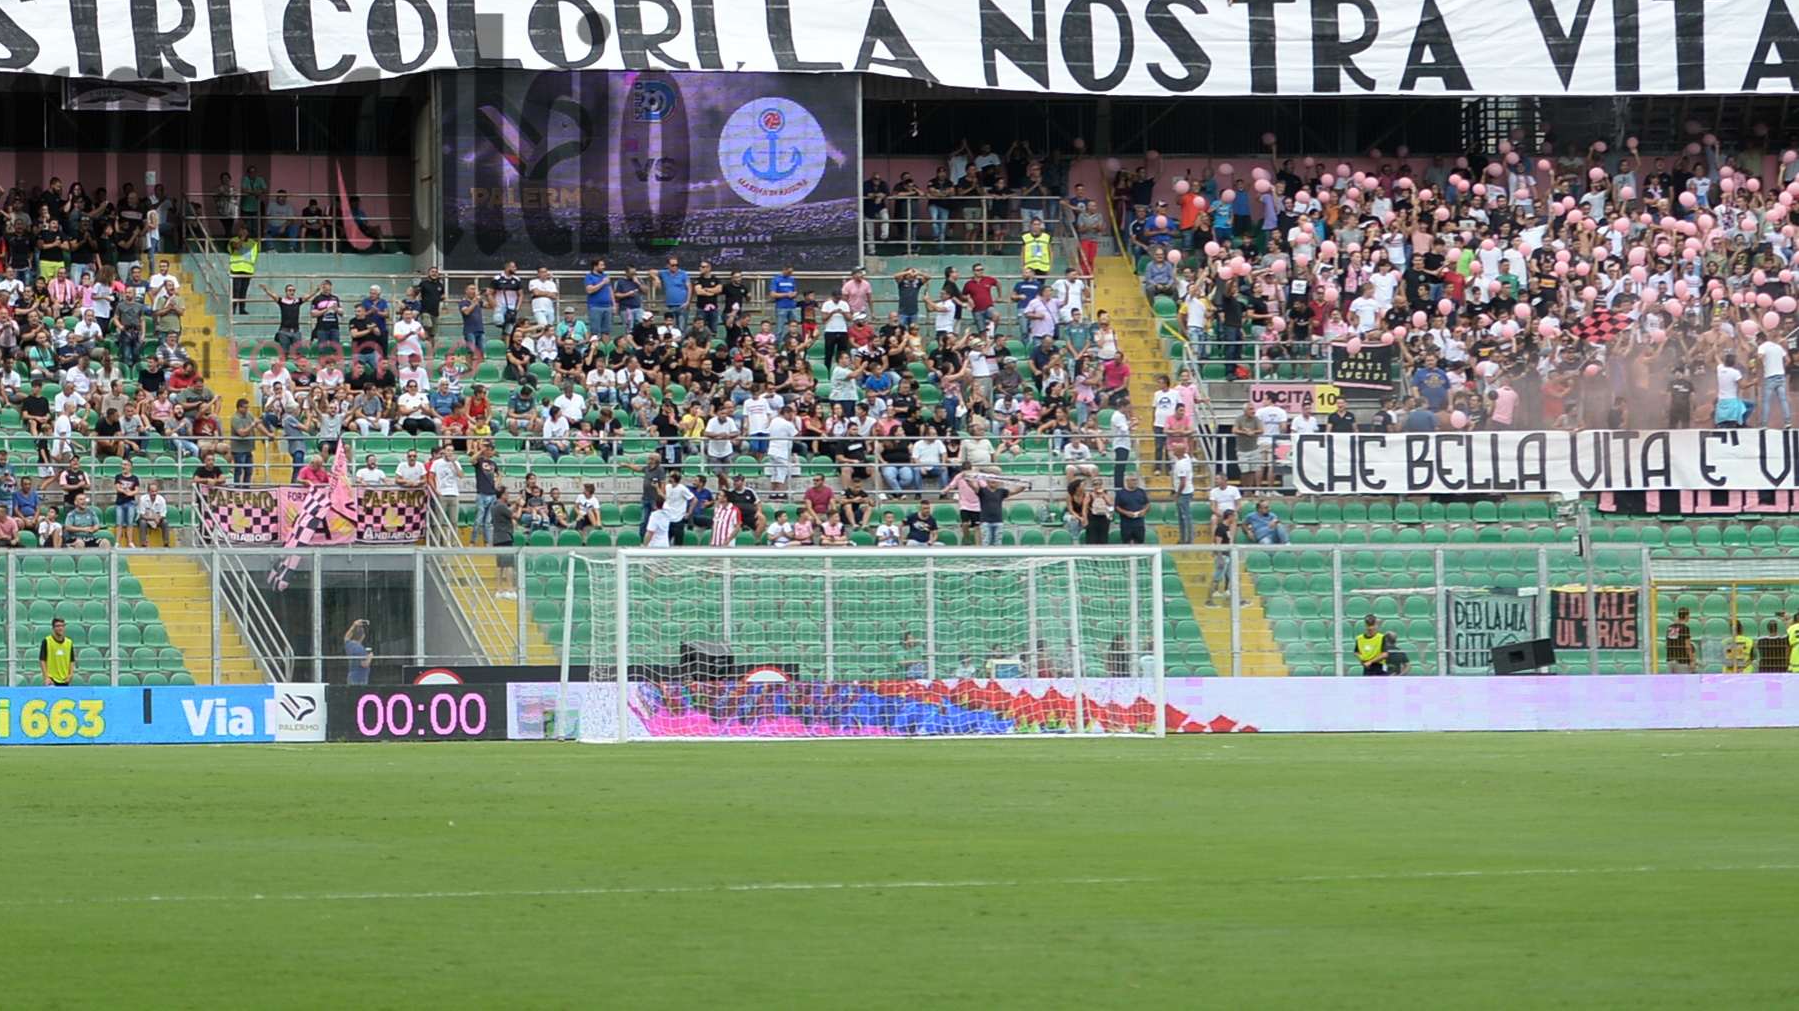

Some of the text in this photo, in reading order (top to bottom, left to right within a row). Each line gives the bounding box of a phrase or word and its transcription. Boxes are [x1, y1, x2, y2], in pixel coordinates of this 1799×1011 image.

[470, 187, 603, 209] PALERMO
[1341, 362, 1382, 371] STATI
[1317, 392, 1338, 406] 10
[1297, 434, 1388, 492] CHE
[1405, 432, 1547, 492] BELLA
[1570, 430, 1672, 490] VITA
[208, 489, 274, 513] PALERMO
[363, 489, 426, 512] PALERMO
[1454, 601, 1528, 632] PER LA MIA
[20, 698, 105, 738] 663
[181, 699, 254, 736] Via
[355, 692, 487, 736] 00:00
[278, 724, 320, 732] PALERMO
